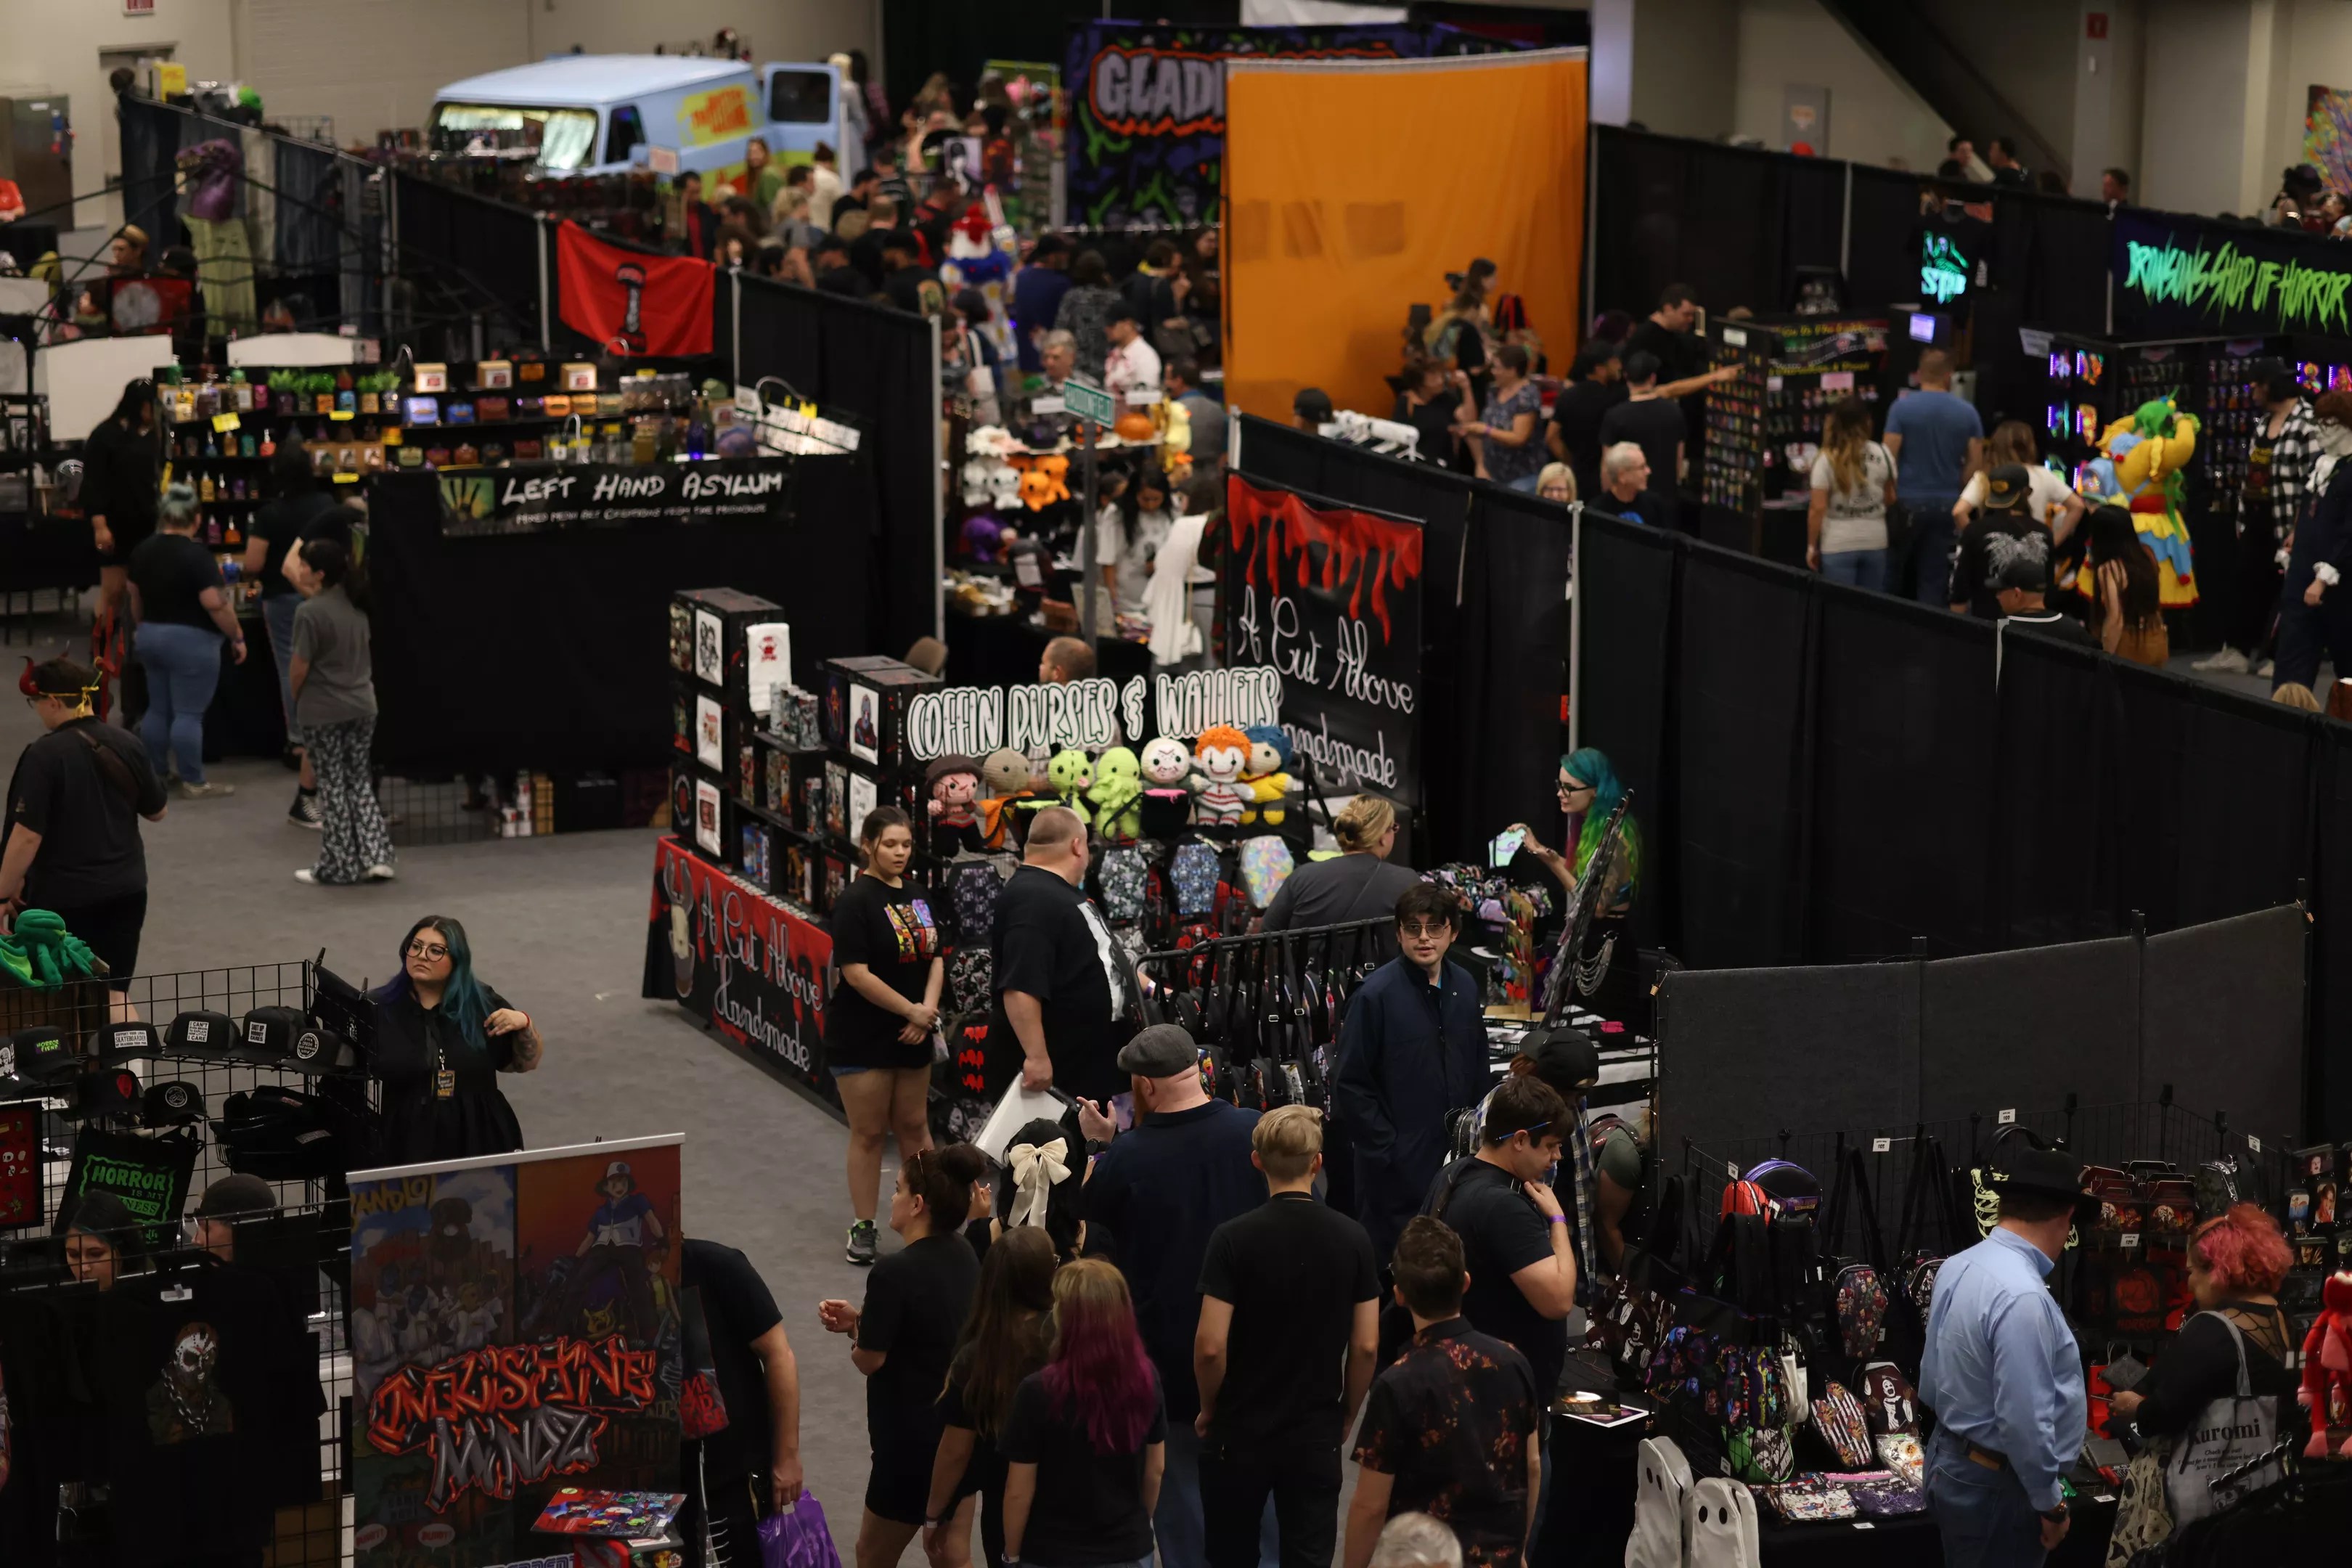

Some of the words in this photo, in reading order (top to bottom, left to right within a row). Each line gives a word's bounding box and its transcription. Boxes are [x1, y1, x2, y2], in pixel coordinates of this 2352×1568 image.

[502, 476, 576, 506] LEFT
[592, 473, 666, 501] HAND
[681, 471, 783, 499] ASYLUM
[1237, 584, 1262, 663] A
[1270, 594, 1323, 685] Cut
[1327, 615, 1416, 714] Above
[907, 688, 1003, 760] COFFIN
[1009, 678, 1116, 751] PURSES
[1156, 666, 1279, 740] WALLETS
[764, 917, 823, 1011] Above
[91, 1165, 166, 1191] HORROR
